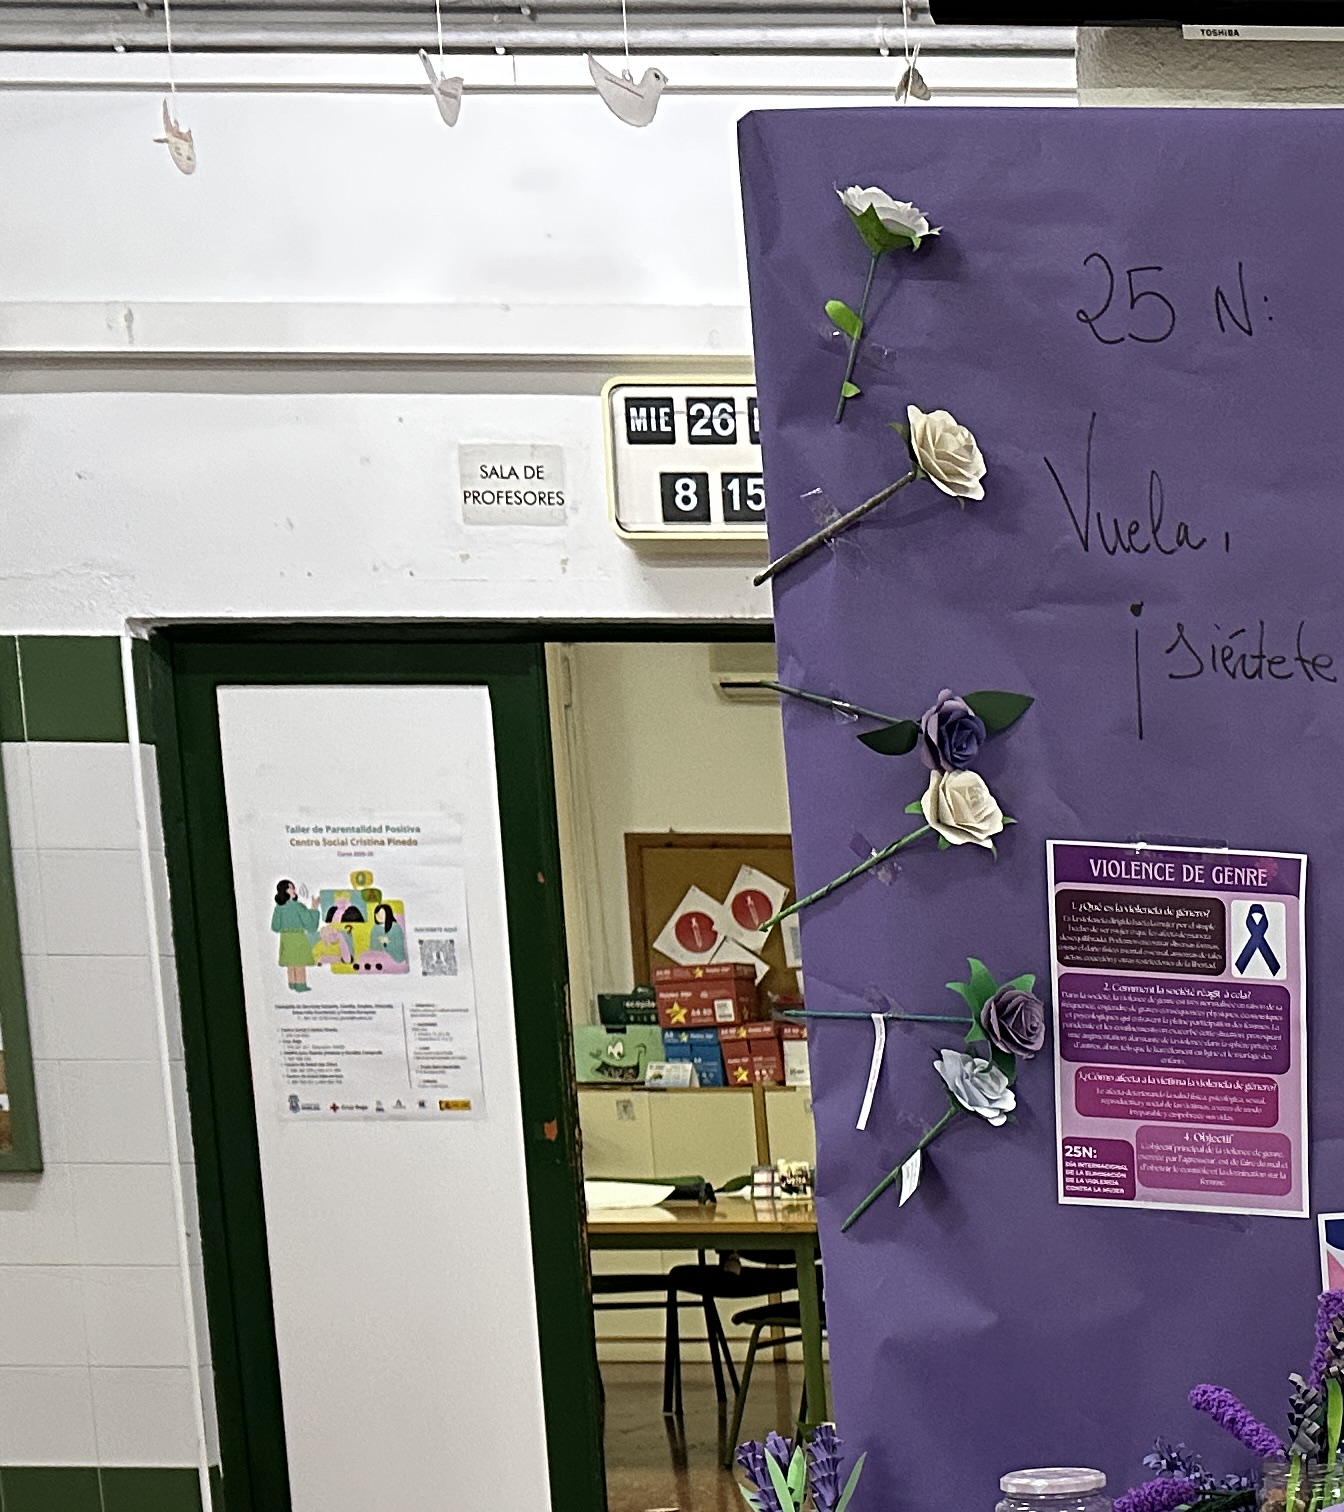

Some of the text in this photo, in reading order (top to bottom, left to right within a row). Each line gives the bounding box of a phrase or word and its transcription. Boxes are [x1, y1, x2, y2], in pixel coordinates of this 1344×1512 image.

[1200, 28, 1240, 37] TOSHIBA
[1075, 252, 1177, 345] 25
[629, 402, 737, 437] MIE 26
[479, 465, 545, 480] SALA DE
[1042, 411, 1231, 557] Vuela,
[463, 490, 565, 506] PROFESORES
[674, 477, 766, 512] 8 15
[285, 825, 421, 834] Taller de Parentalidad Positiva
[290, 838, 418, 847] Centro Social Cristina Pinedo
[1089, 858, 1268, 887] VIOLENCE DE GENRE
[1064, 1145, 1098, 1159] 25N:
